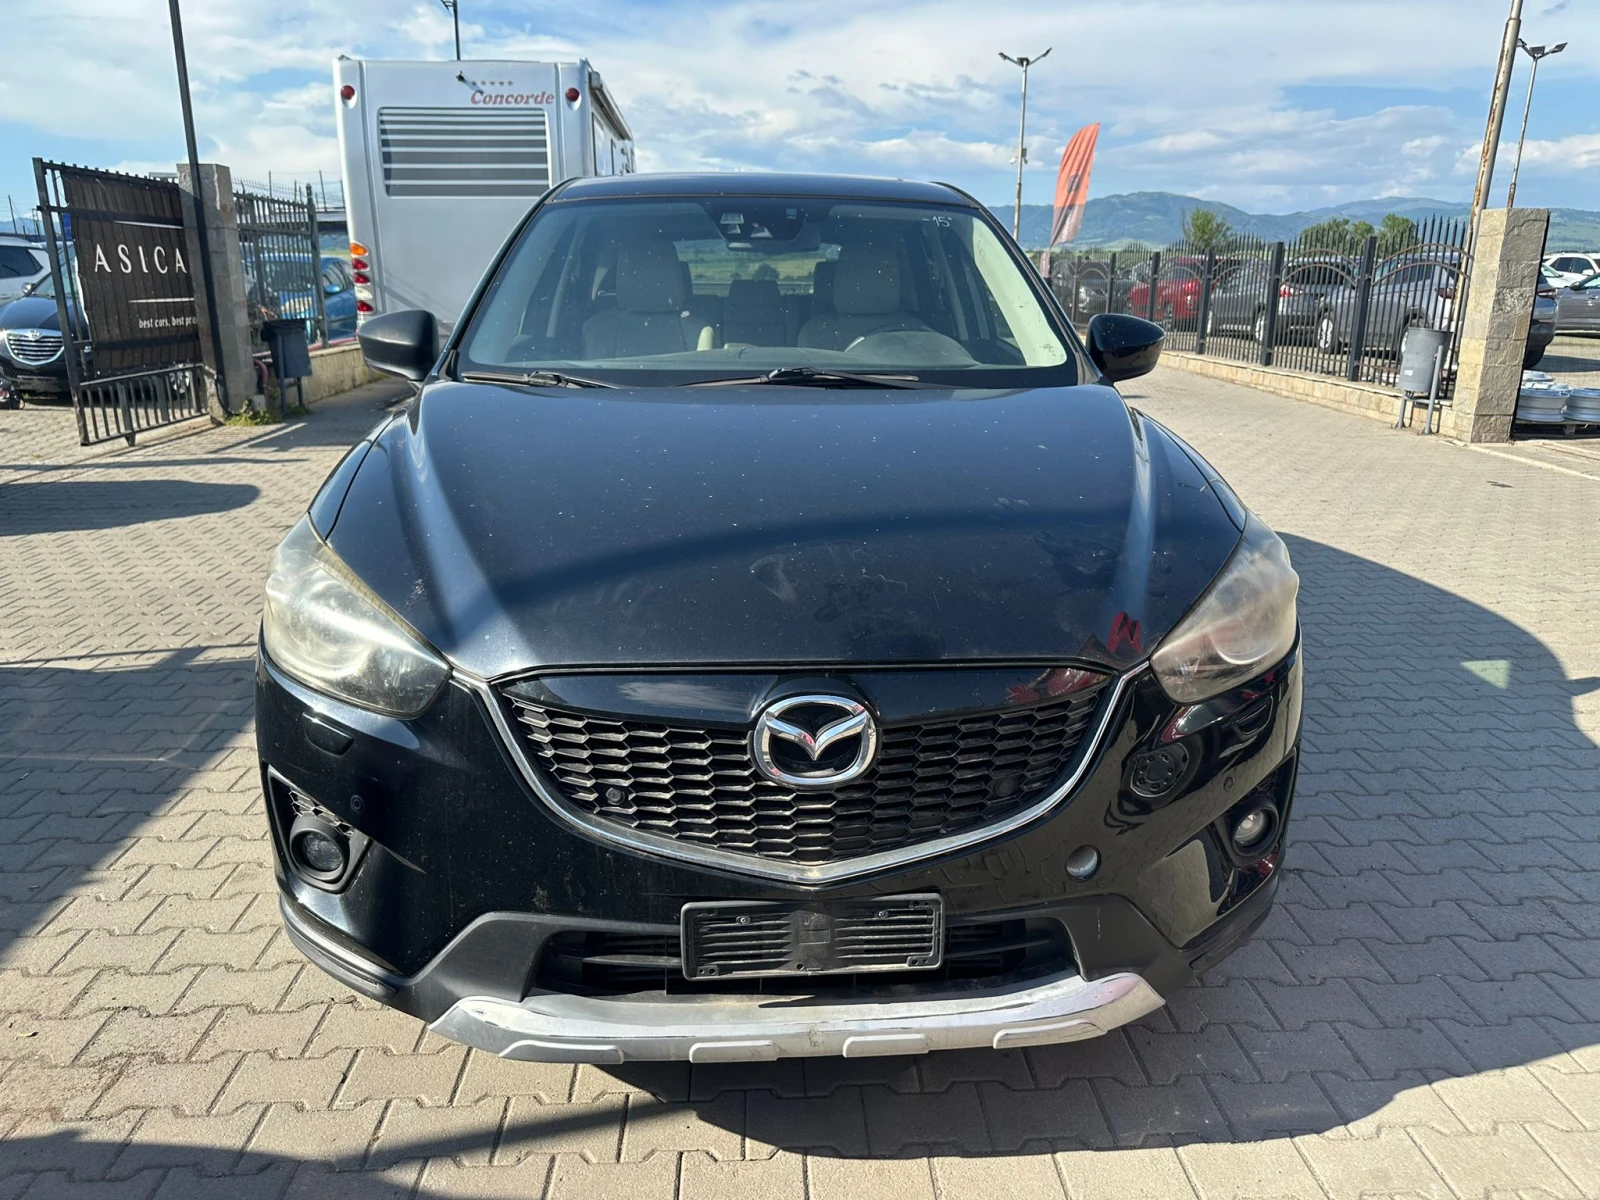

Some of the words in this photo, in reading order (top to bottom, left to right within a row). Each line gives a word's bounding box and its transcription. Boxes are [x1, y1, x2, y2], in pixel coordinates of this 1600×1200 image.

[470, 90, 554, 105] Concorde
[95, 244, 188, 274] ASICA
[139, 318, 154, 329] best
[171, 315, 185, 327] best
